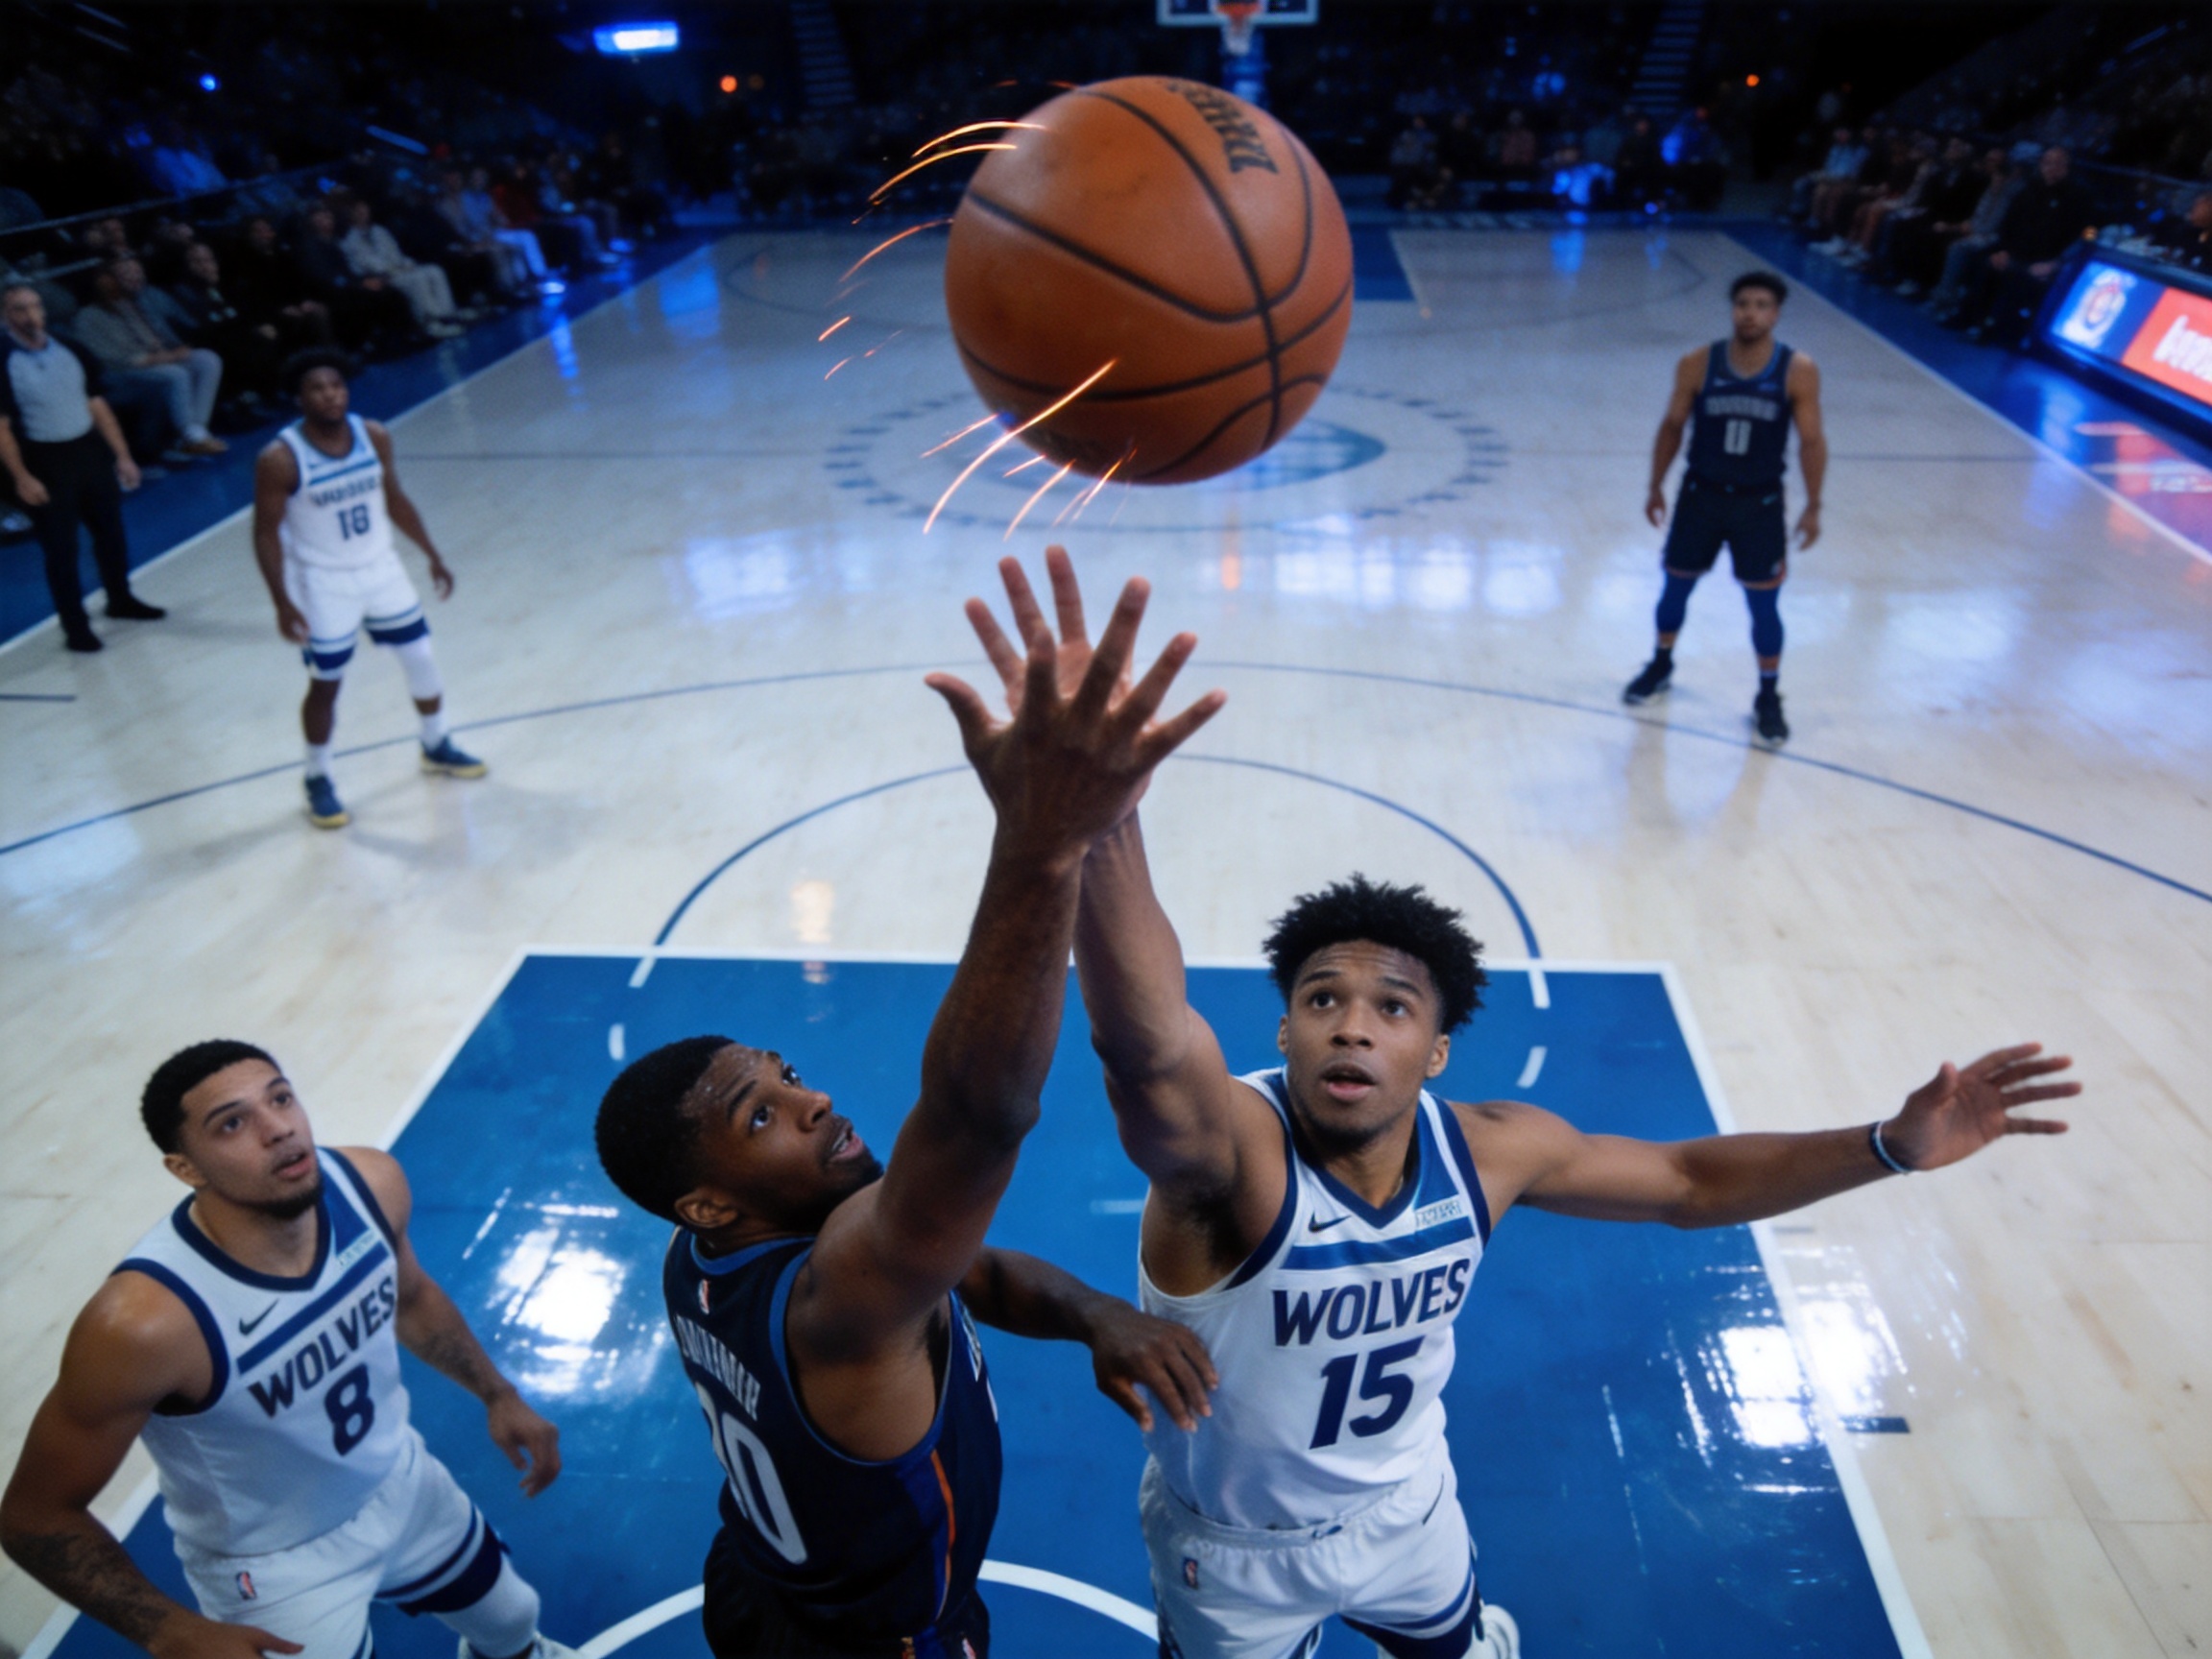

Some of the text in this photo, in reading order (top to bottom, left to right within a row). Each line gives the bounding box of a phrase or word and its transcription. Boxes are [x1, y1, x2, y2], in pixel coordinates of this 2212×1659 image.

[337, 504, 371, 541] 18
[247, 1276, 397, 1418] WOLVES
[1271, 1259, 1471, 1346] WOLVES
[324, 1361, 375, 1456] 8
[1309, 1334, 1427, 1450] 15
